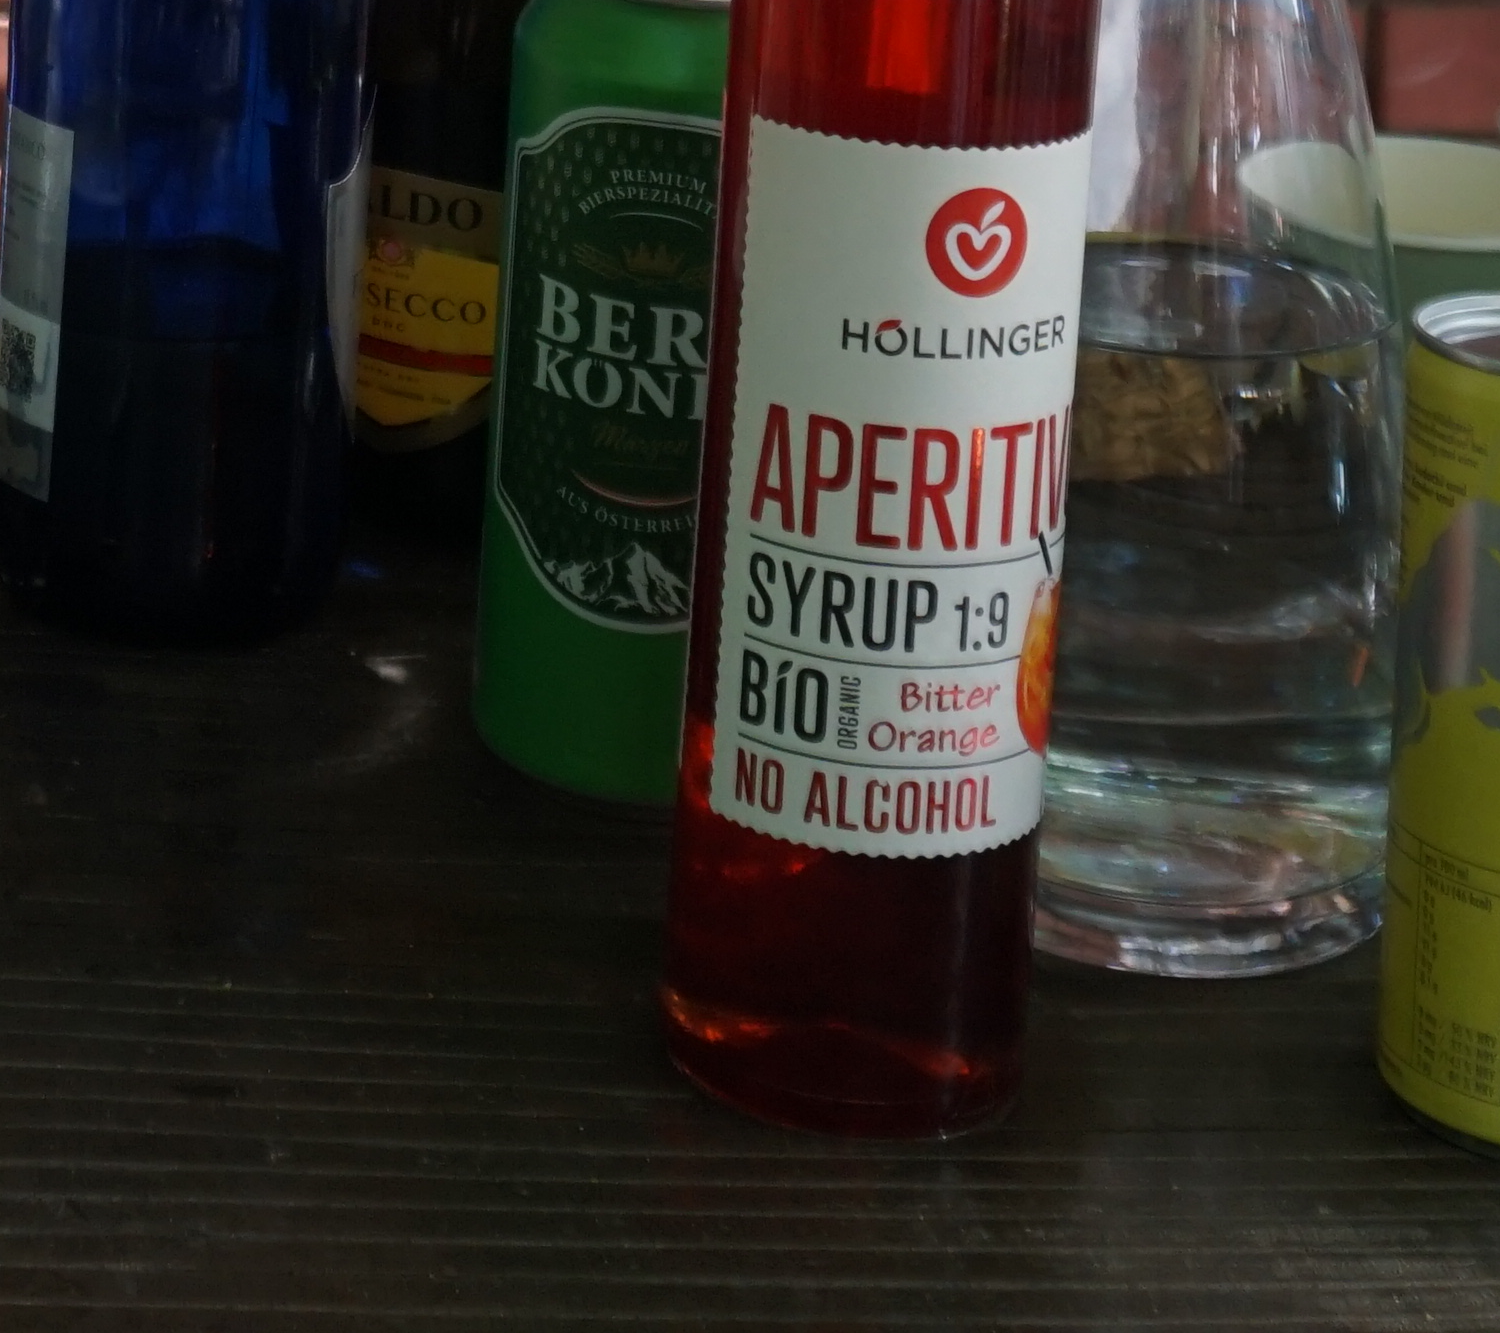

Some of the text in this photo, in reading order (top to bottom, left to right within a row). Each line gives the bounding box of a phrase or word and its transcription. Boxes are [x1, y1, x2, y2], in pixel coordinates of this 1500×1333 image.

[578, 186, 717, 219] BIERSPEZIALIT
[609, 169, 707, 195] PREMIUM
[381, 183, 484, 232] LDO
[366, 283, 487, 325] SECCO
[535, 273, 708, 368] BER
[532, 339, 707, 421] KÖNI
[556, 486, 696, 534] AUS ÖSTERREI
[746, 552, 1010, 653] SYRUP 1:9
[837, 675, 862, 751] ORGANIC
[900, 681, 1001, 714] Bitter
[867, 721, 1001, 757] Orange
[734, 747, 997, 836] NO ALCOHOL
